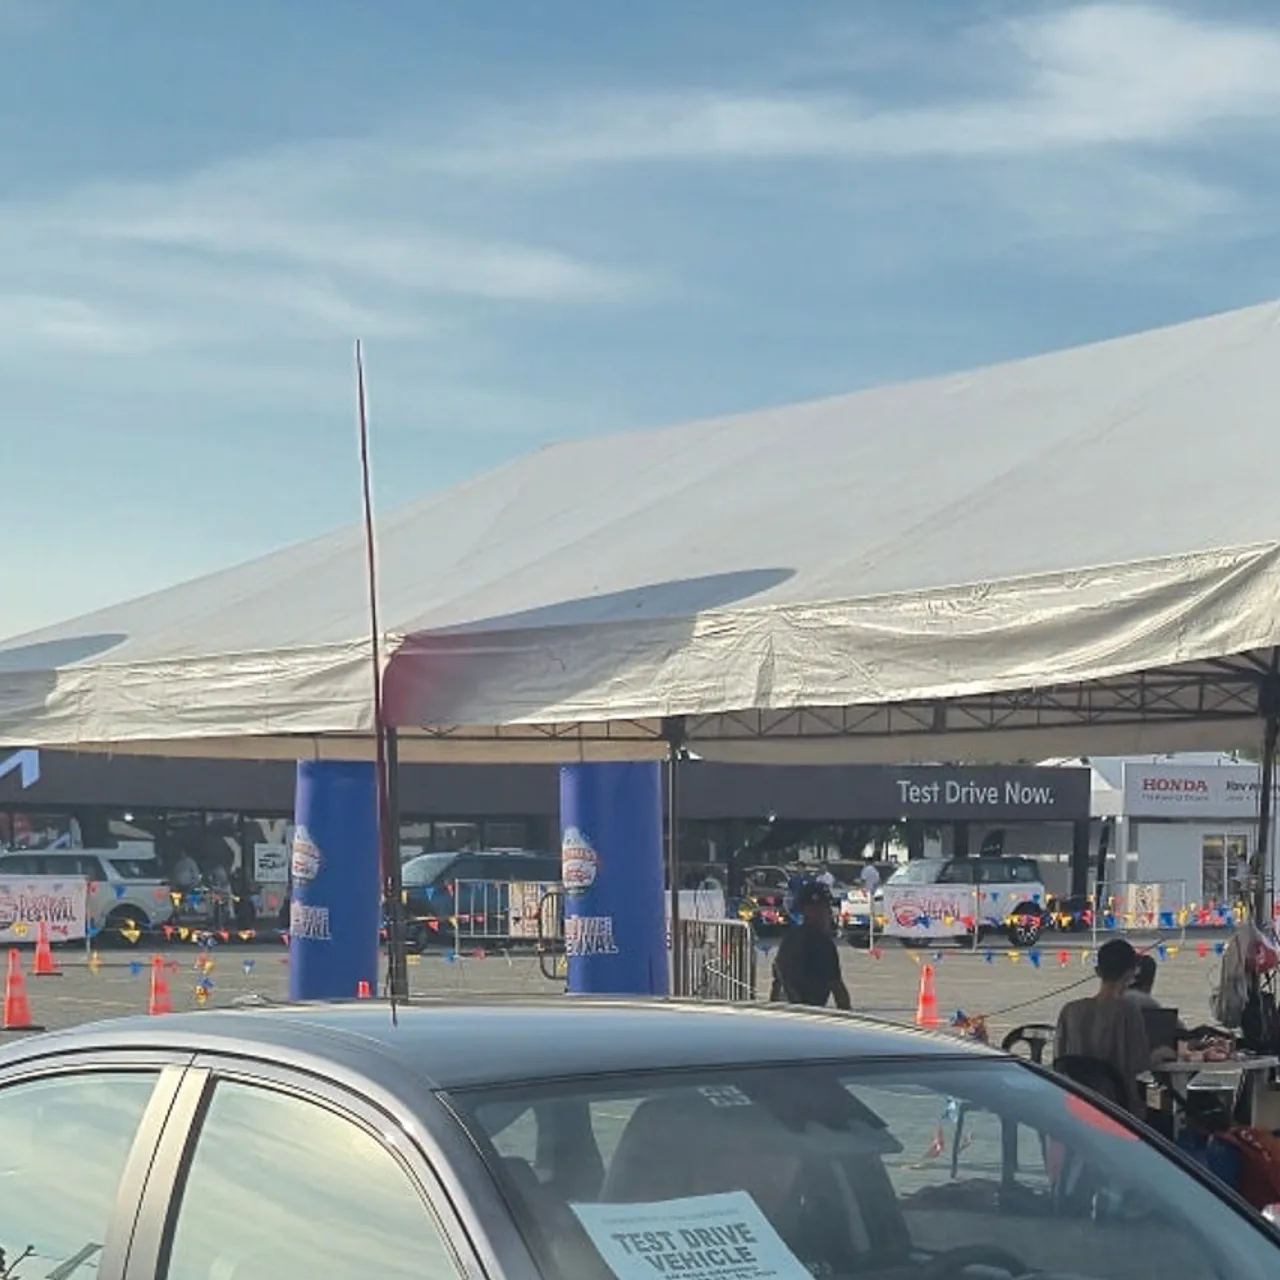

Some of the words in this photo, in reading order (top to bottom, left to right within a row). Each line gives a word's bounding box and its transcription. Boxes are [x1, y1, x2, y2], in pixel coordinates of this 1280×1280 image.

[896, 780, 940, 803] Test
[945, 780, 999, 804] Drive
[1004, 781, 1054, 804] Now.
[1143, 779, 1209, 792] HONDA
[611, 1231, 677, 1256] TEST
[678, 1222, 758, 1249] DRIVE
[644, 1246, 757, 1272] VEHICLE
